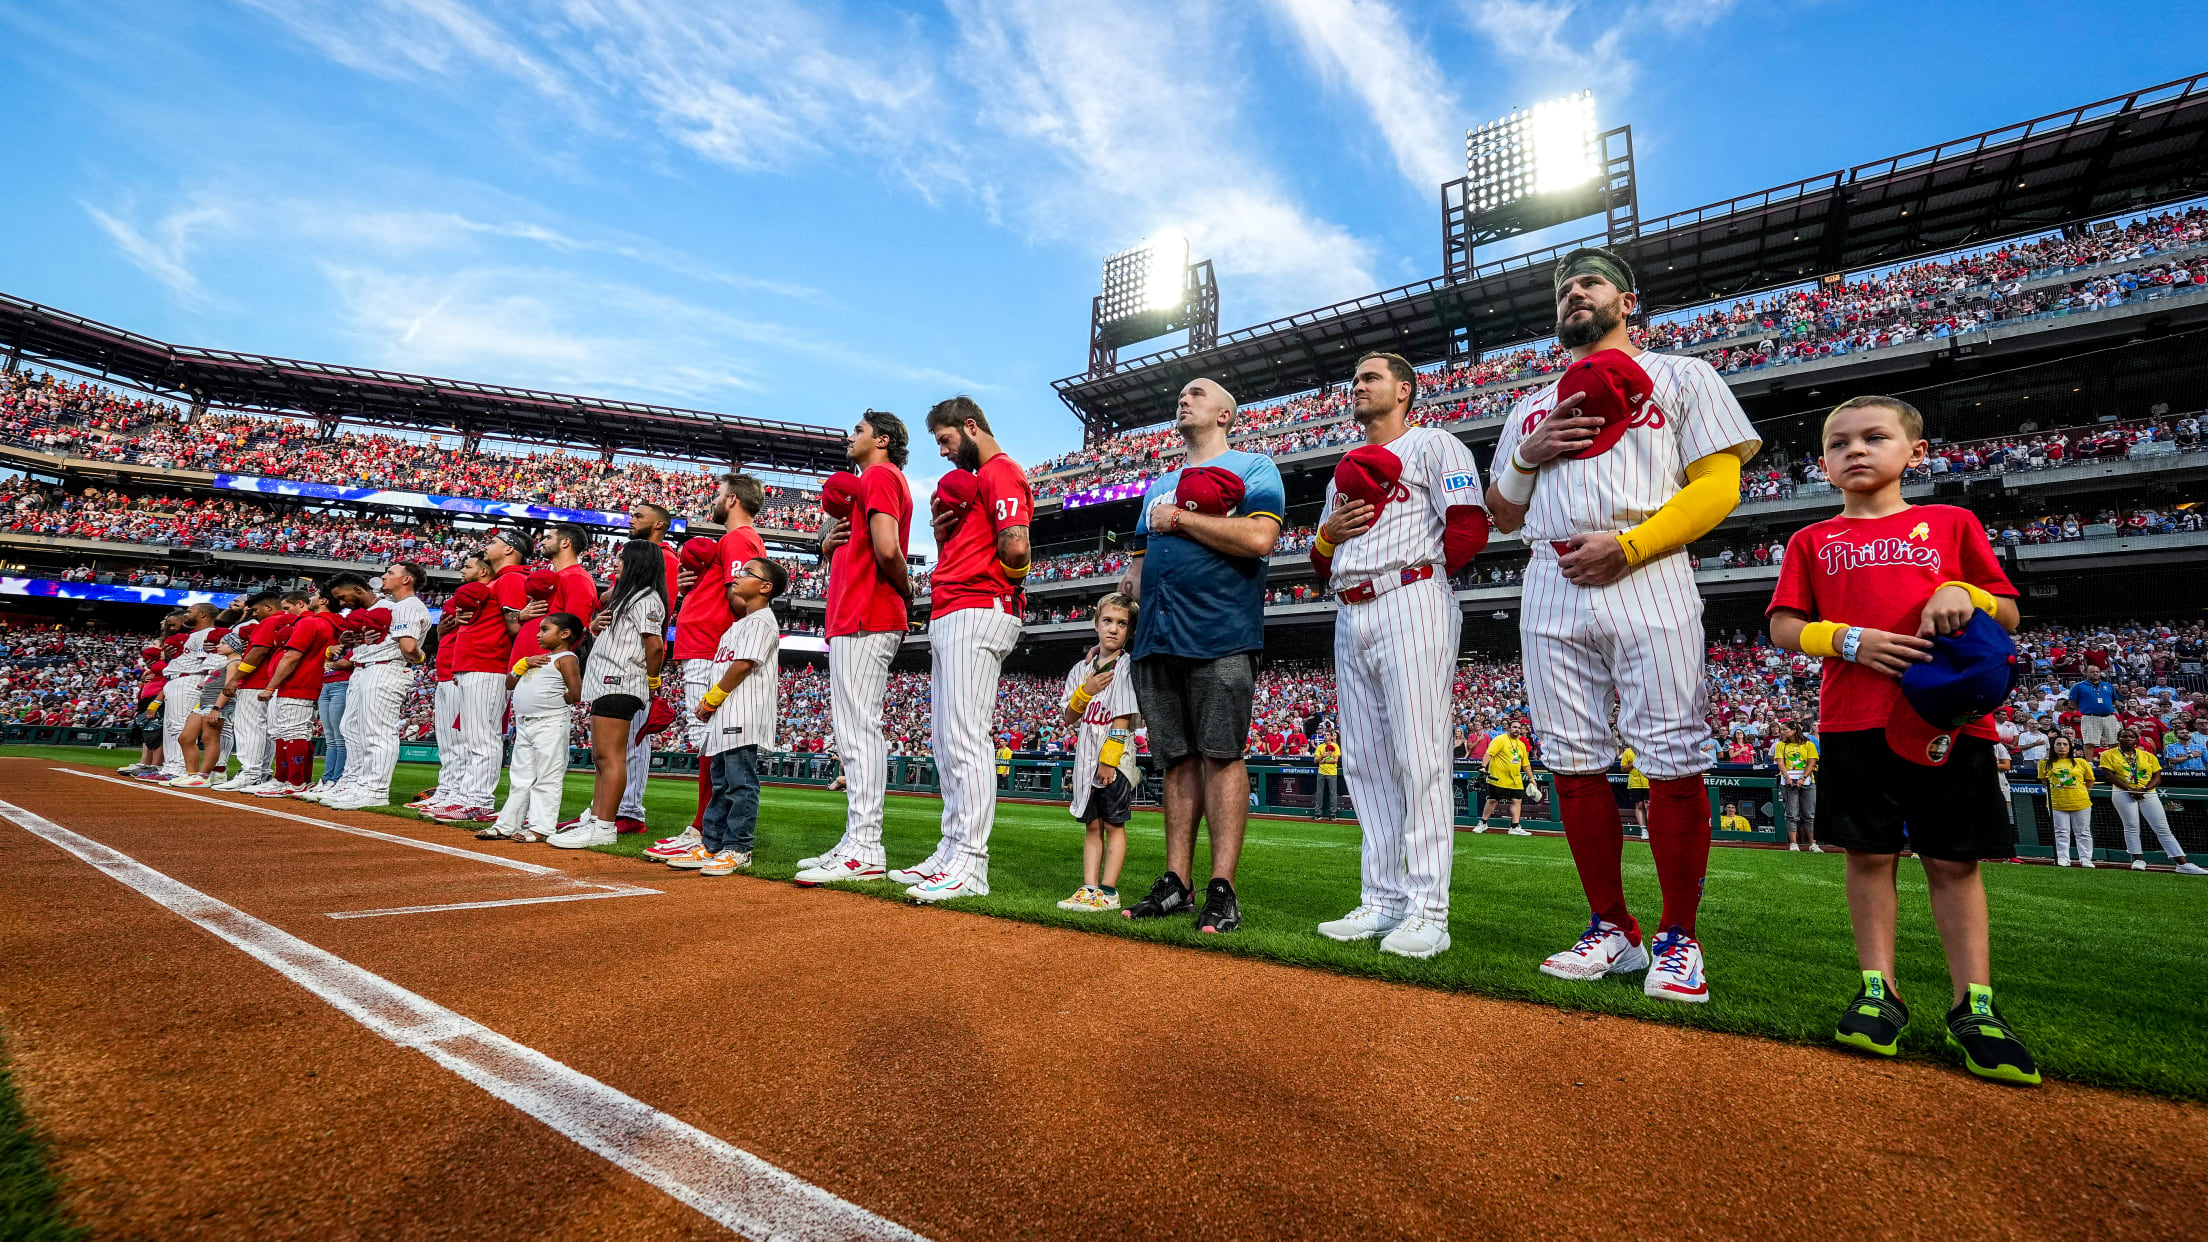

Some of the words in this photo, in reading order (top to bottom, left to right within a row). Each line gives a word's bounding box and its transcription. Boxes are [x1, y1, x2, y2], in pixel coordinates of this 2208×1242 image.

[1445, 475, 1476, 490] IBX
[996, 498, 1019, 520] 37
[1819, 538, 1941, 575] Phillies
[1083, 701, 1112, 725] llie
[1870, 977, 1881, 998] das
[1975, 993, 1989, 1015] das
